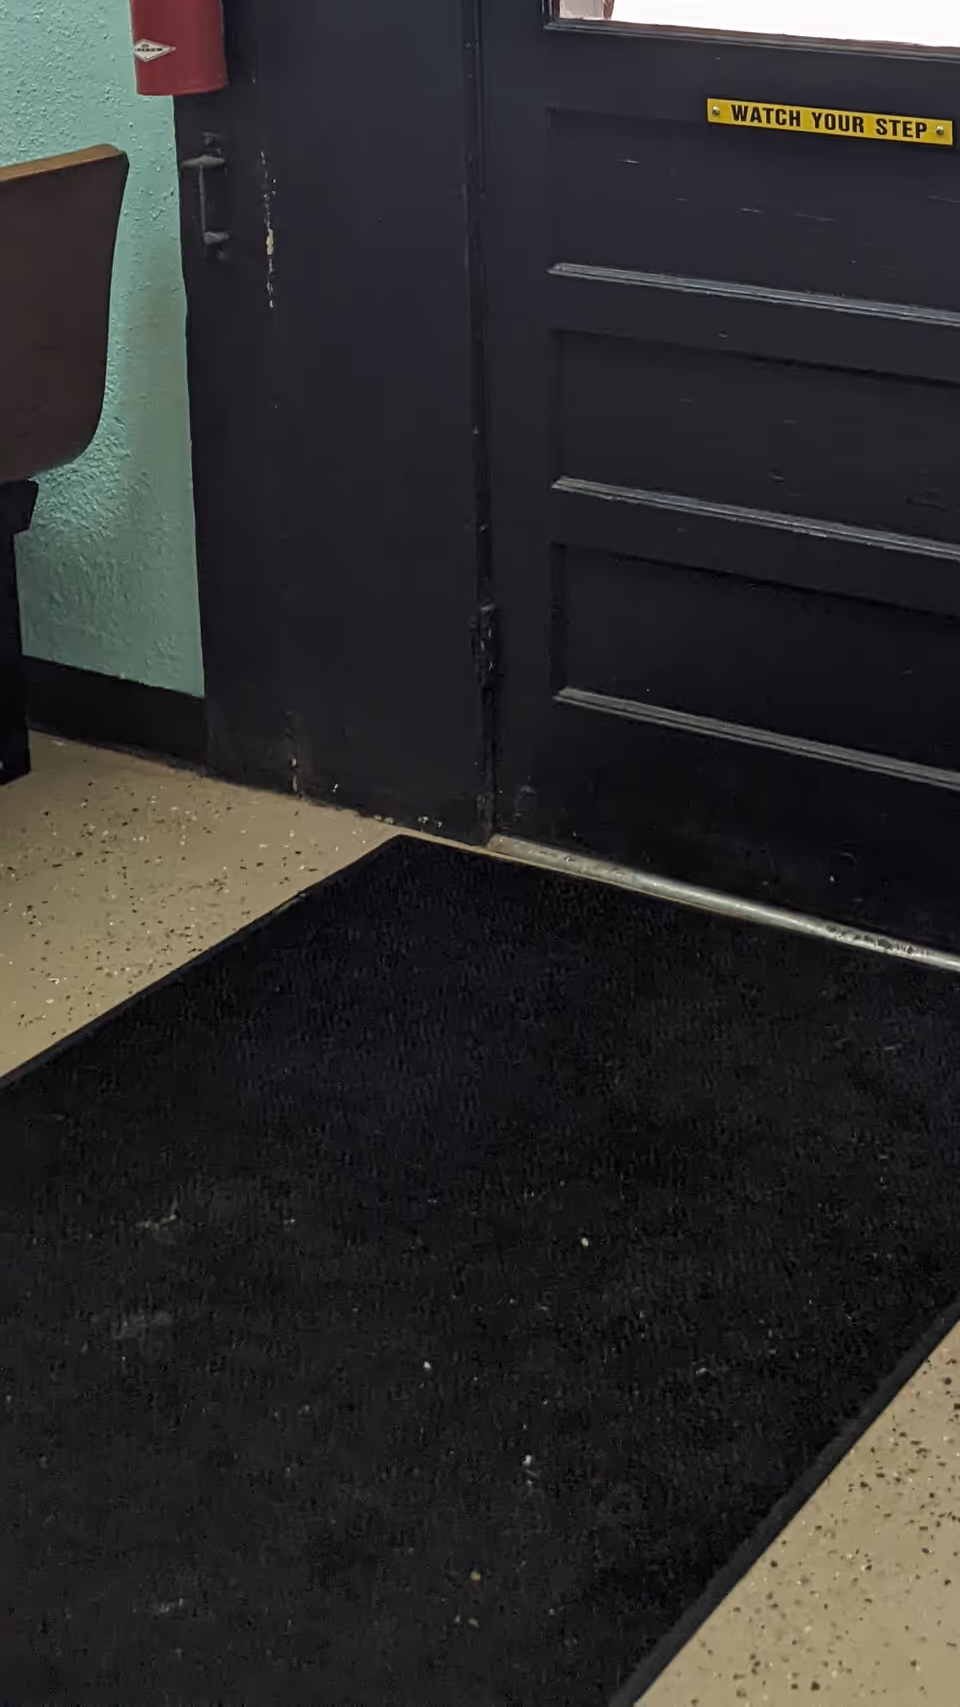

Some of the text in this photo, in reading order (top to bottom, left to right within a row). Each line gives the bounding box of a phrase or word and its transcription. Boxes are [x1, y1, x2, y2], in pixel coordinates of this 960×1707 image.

[731, 104, 928, 139] WATCH YOUR STEP
